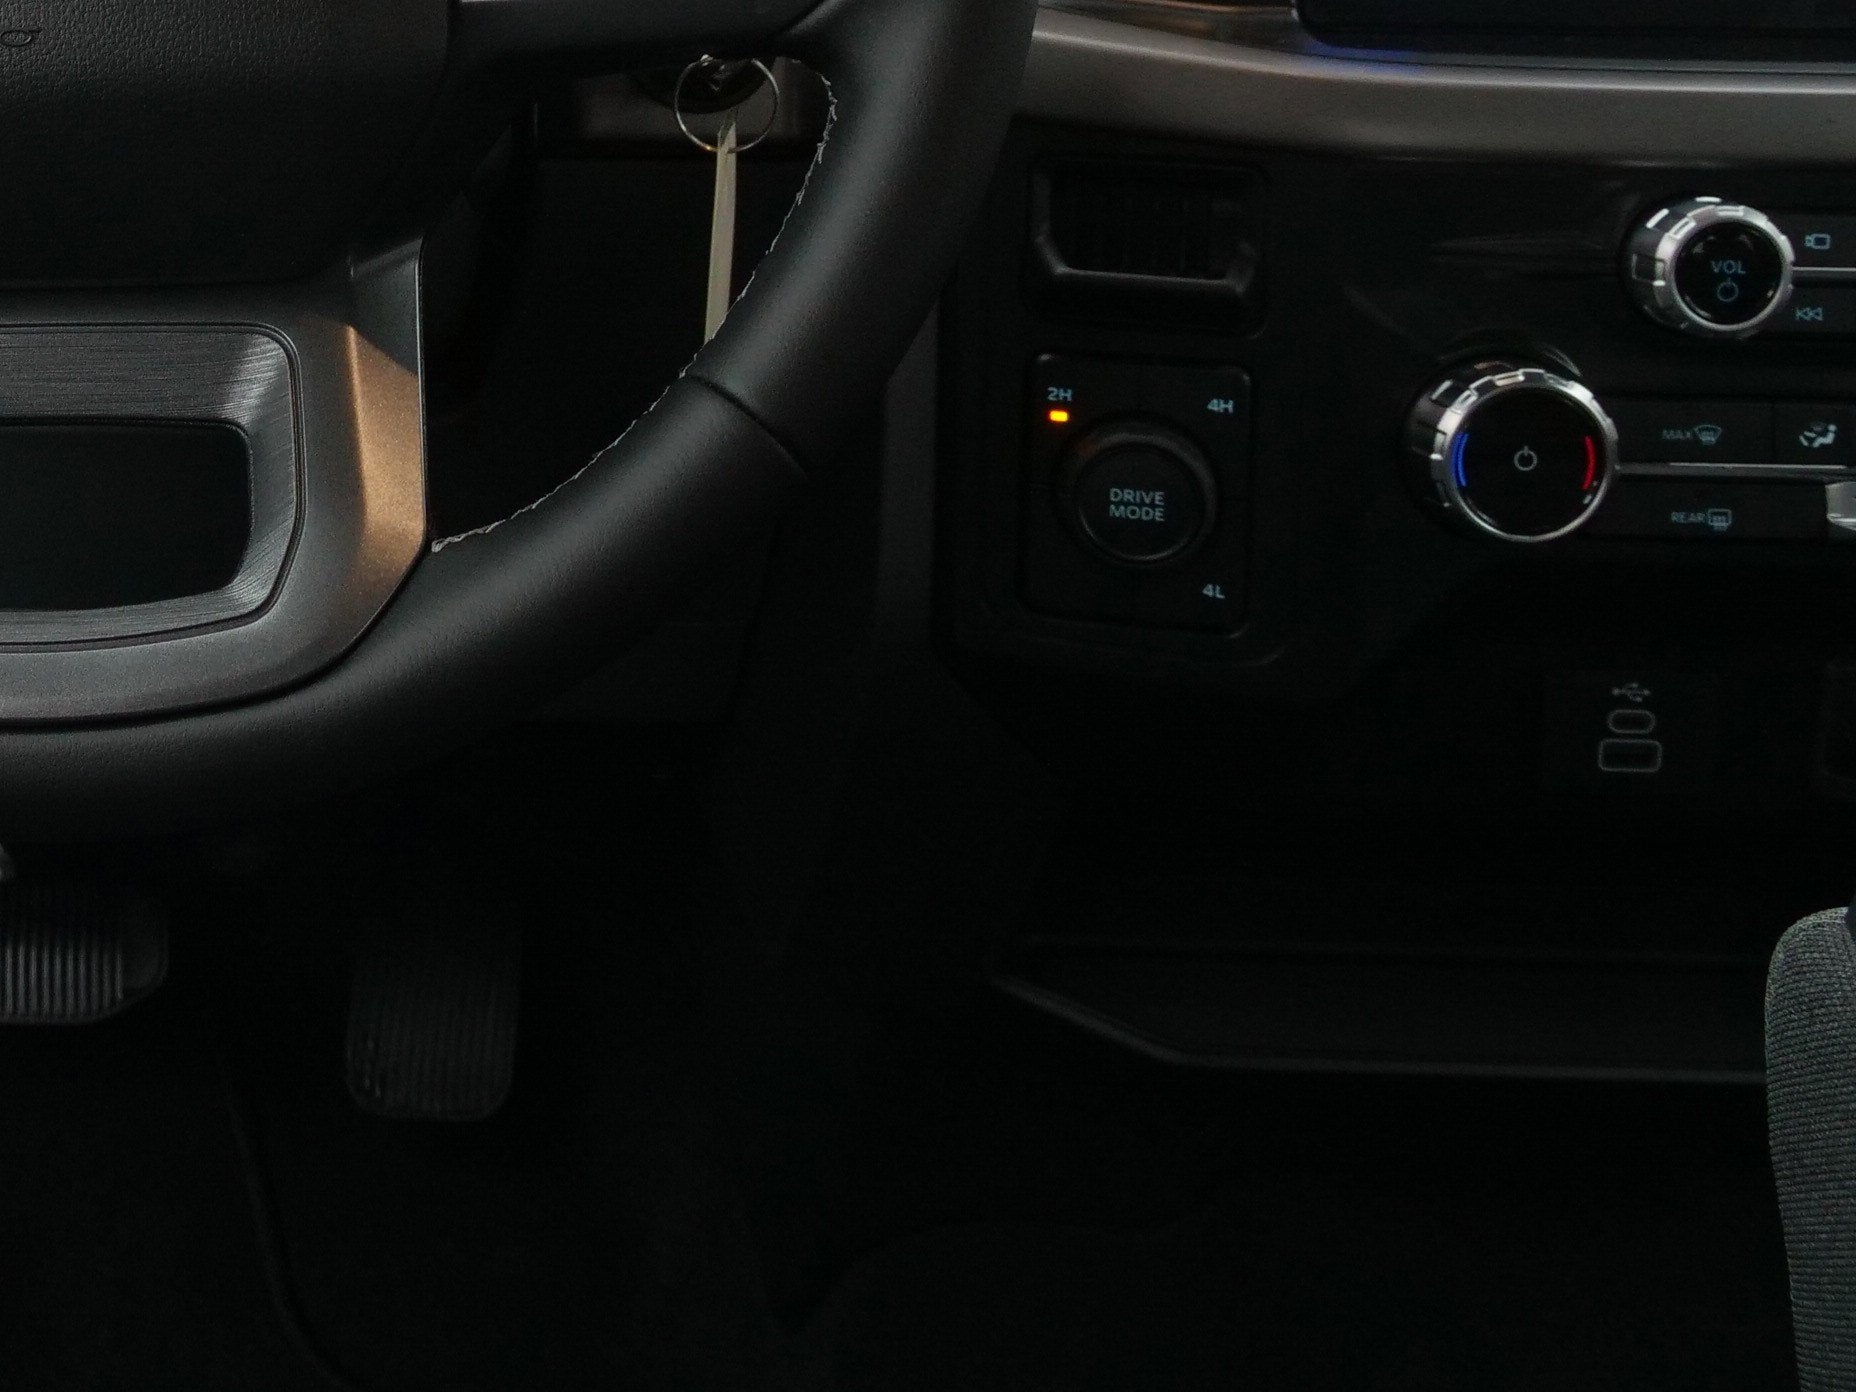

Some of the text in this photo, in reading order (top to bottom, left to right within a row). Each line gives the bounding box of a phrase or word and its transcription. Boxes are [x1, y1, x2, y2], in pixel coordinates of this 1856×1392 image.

[1710, 259, 1746, 275] VOL
[1046, 386, 1073, 402] 2H
[1206, 398, 1234, 414] 4H
[1108, 487, 1165, 506] DRIVE
[1108, 504, 1166, 522] MODE
[1201, 583, 1226, 600] 4L
